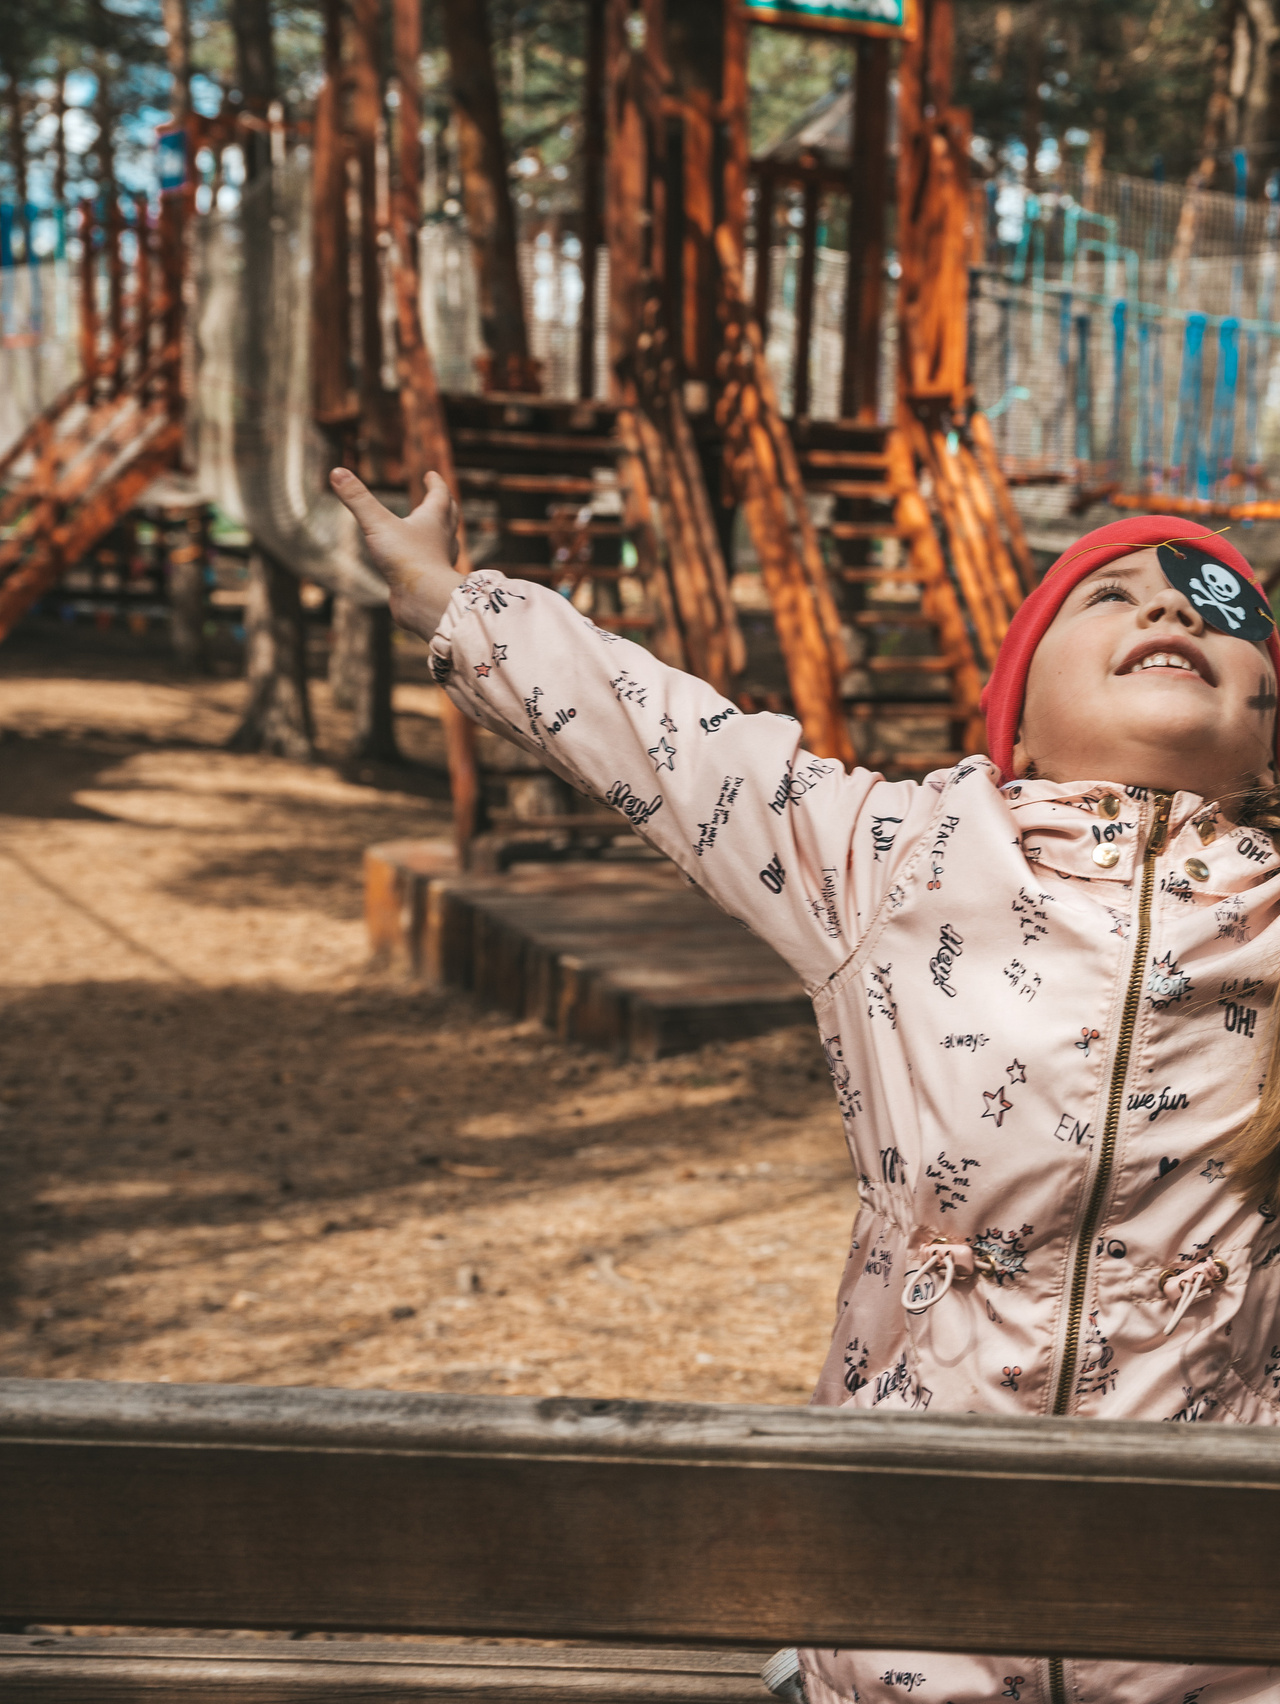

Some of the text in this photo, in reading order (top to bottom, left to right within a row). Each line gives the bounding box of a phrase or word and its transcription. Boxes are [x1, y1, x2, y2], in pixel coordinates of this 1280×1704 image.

[700, 707, 739, 736] love
[930, 815, 960, 860] PEACE
[1237, 836, 1274, 865] OH!
[929, 923, 964, 998] Hey!
[1224, 1001, 1258, 1039] OH!
[939, 1033, 990, 1053] -always-
[1149, 1086, 1190, 1121] fun
[952, 1176, 971, 1187] me
[912, 1282, 934, 1303] AY
[879, 1669, 927, 1692] -always-
